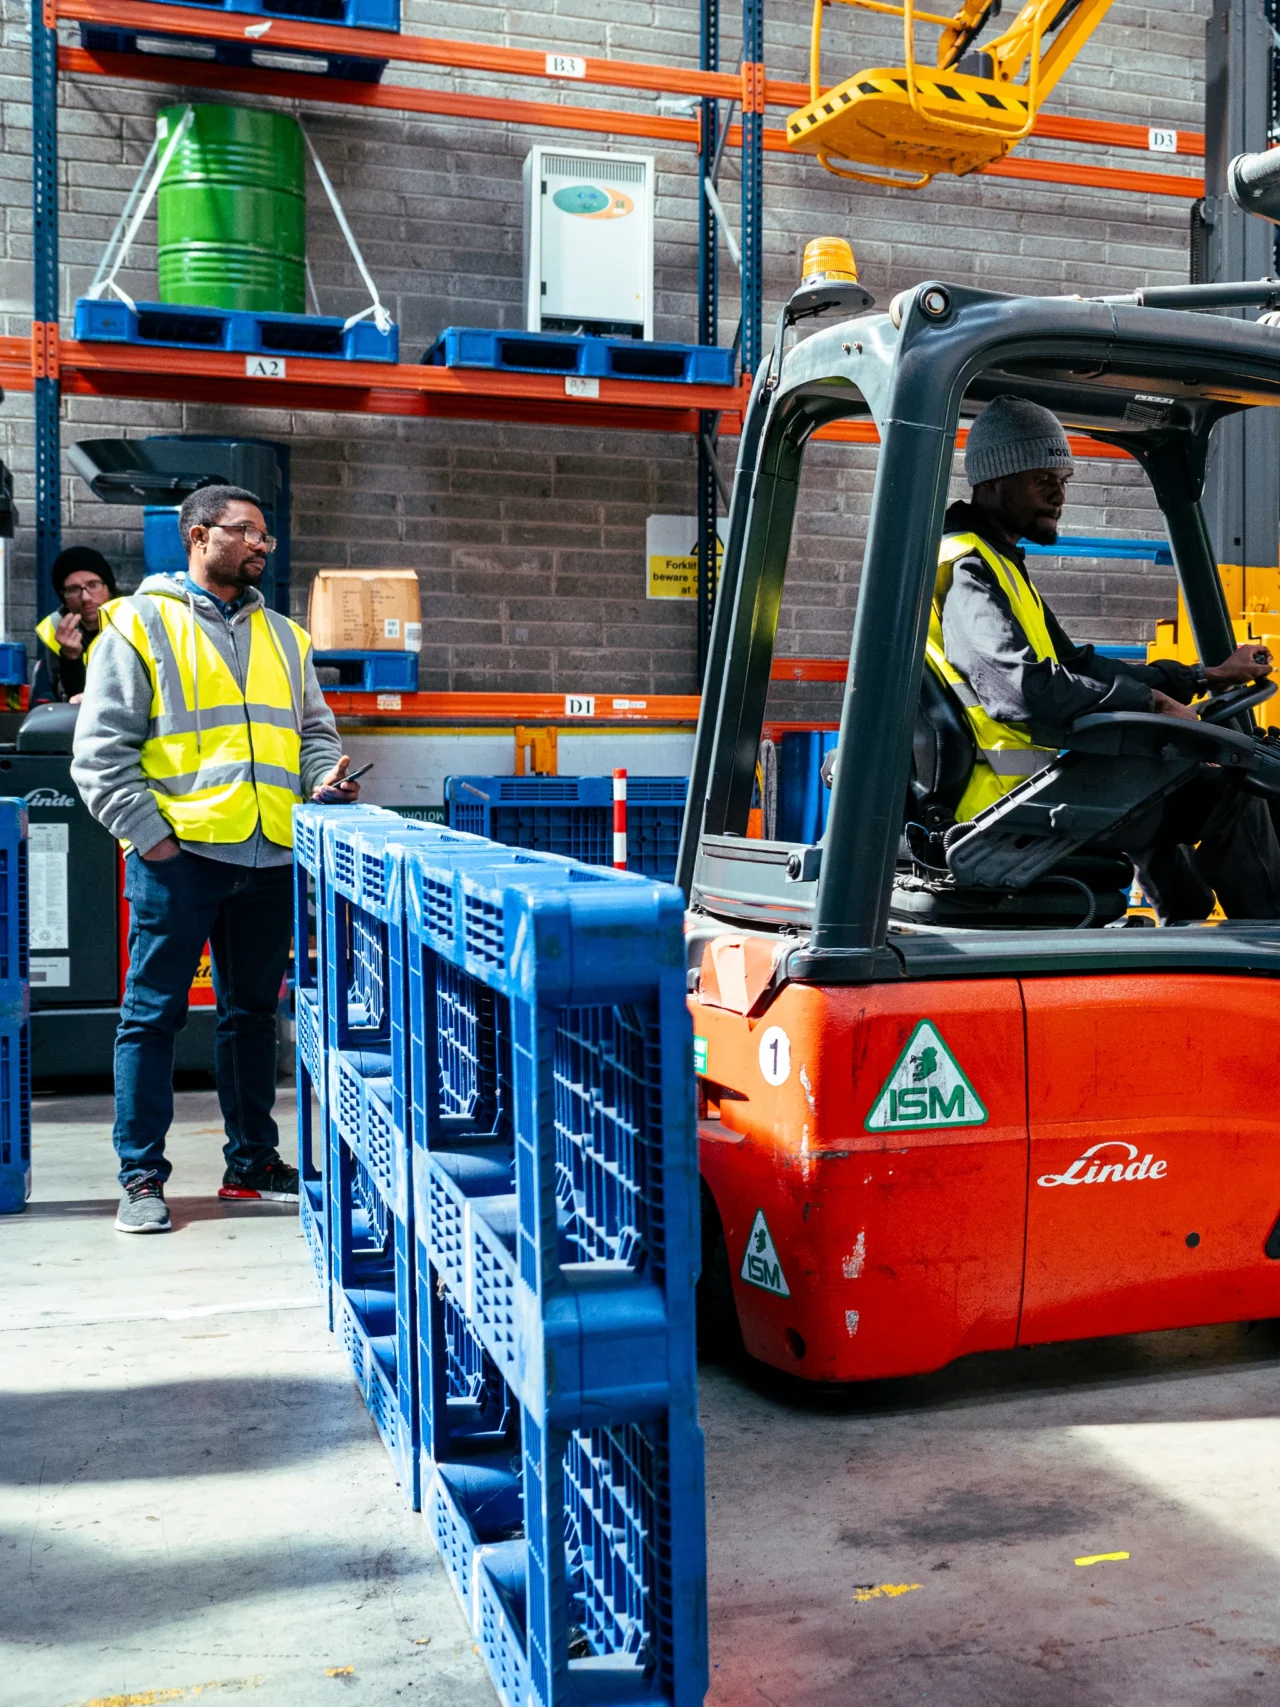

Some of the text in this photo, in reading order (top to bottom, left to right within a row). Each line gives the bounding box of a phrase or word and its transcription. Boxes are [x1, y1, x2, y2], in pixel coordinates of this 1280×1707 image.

[552, 56, 578, 75] B3
[1153, 131, 1175, 149] D3
[252, 359, 281, 377] A2
[666, 560, 697, 570] Forklif
[653, 572, 689, 582] beware
[570, 699, 592, 714] D1
[23, 788, 75, 807] Linde
[401, 811, 444, 822] MOTORI
[769, 1038, 778, 1075] 1
[890, 1084, 966, 1122] ISM
[1037, 1141, 1168, 1187] Linde
[747, 1253, 781, 1290] ISM
